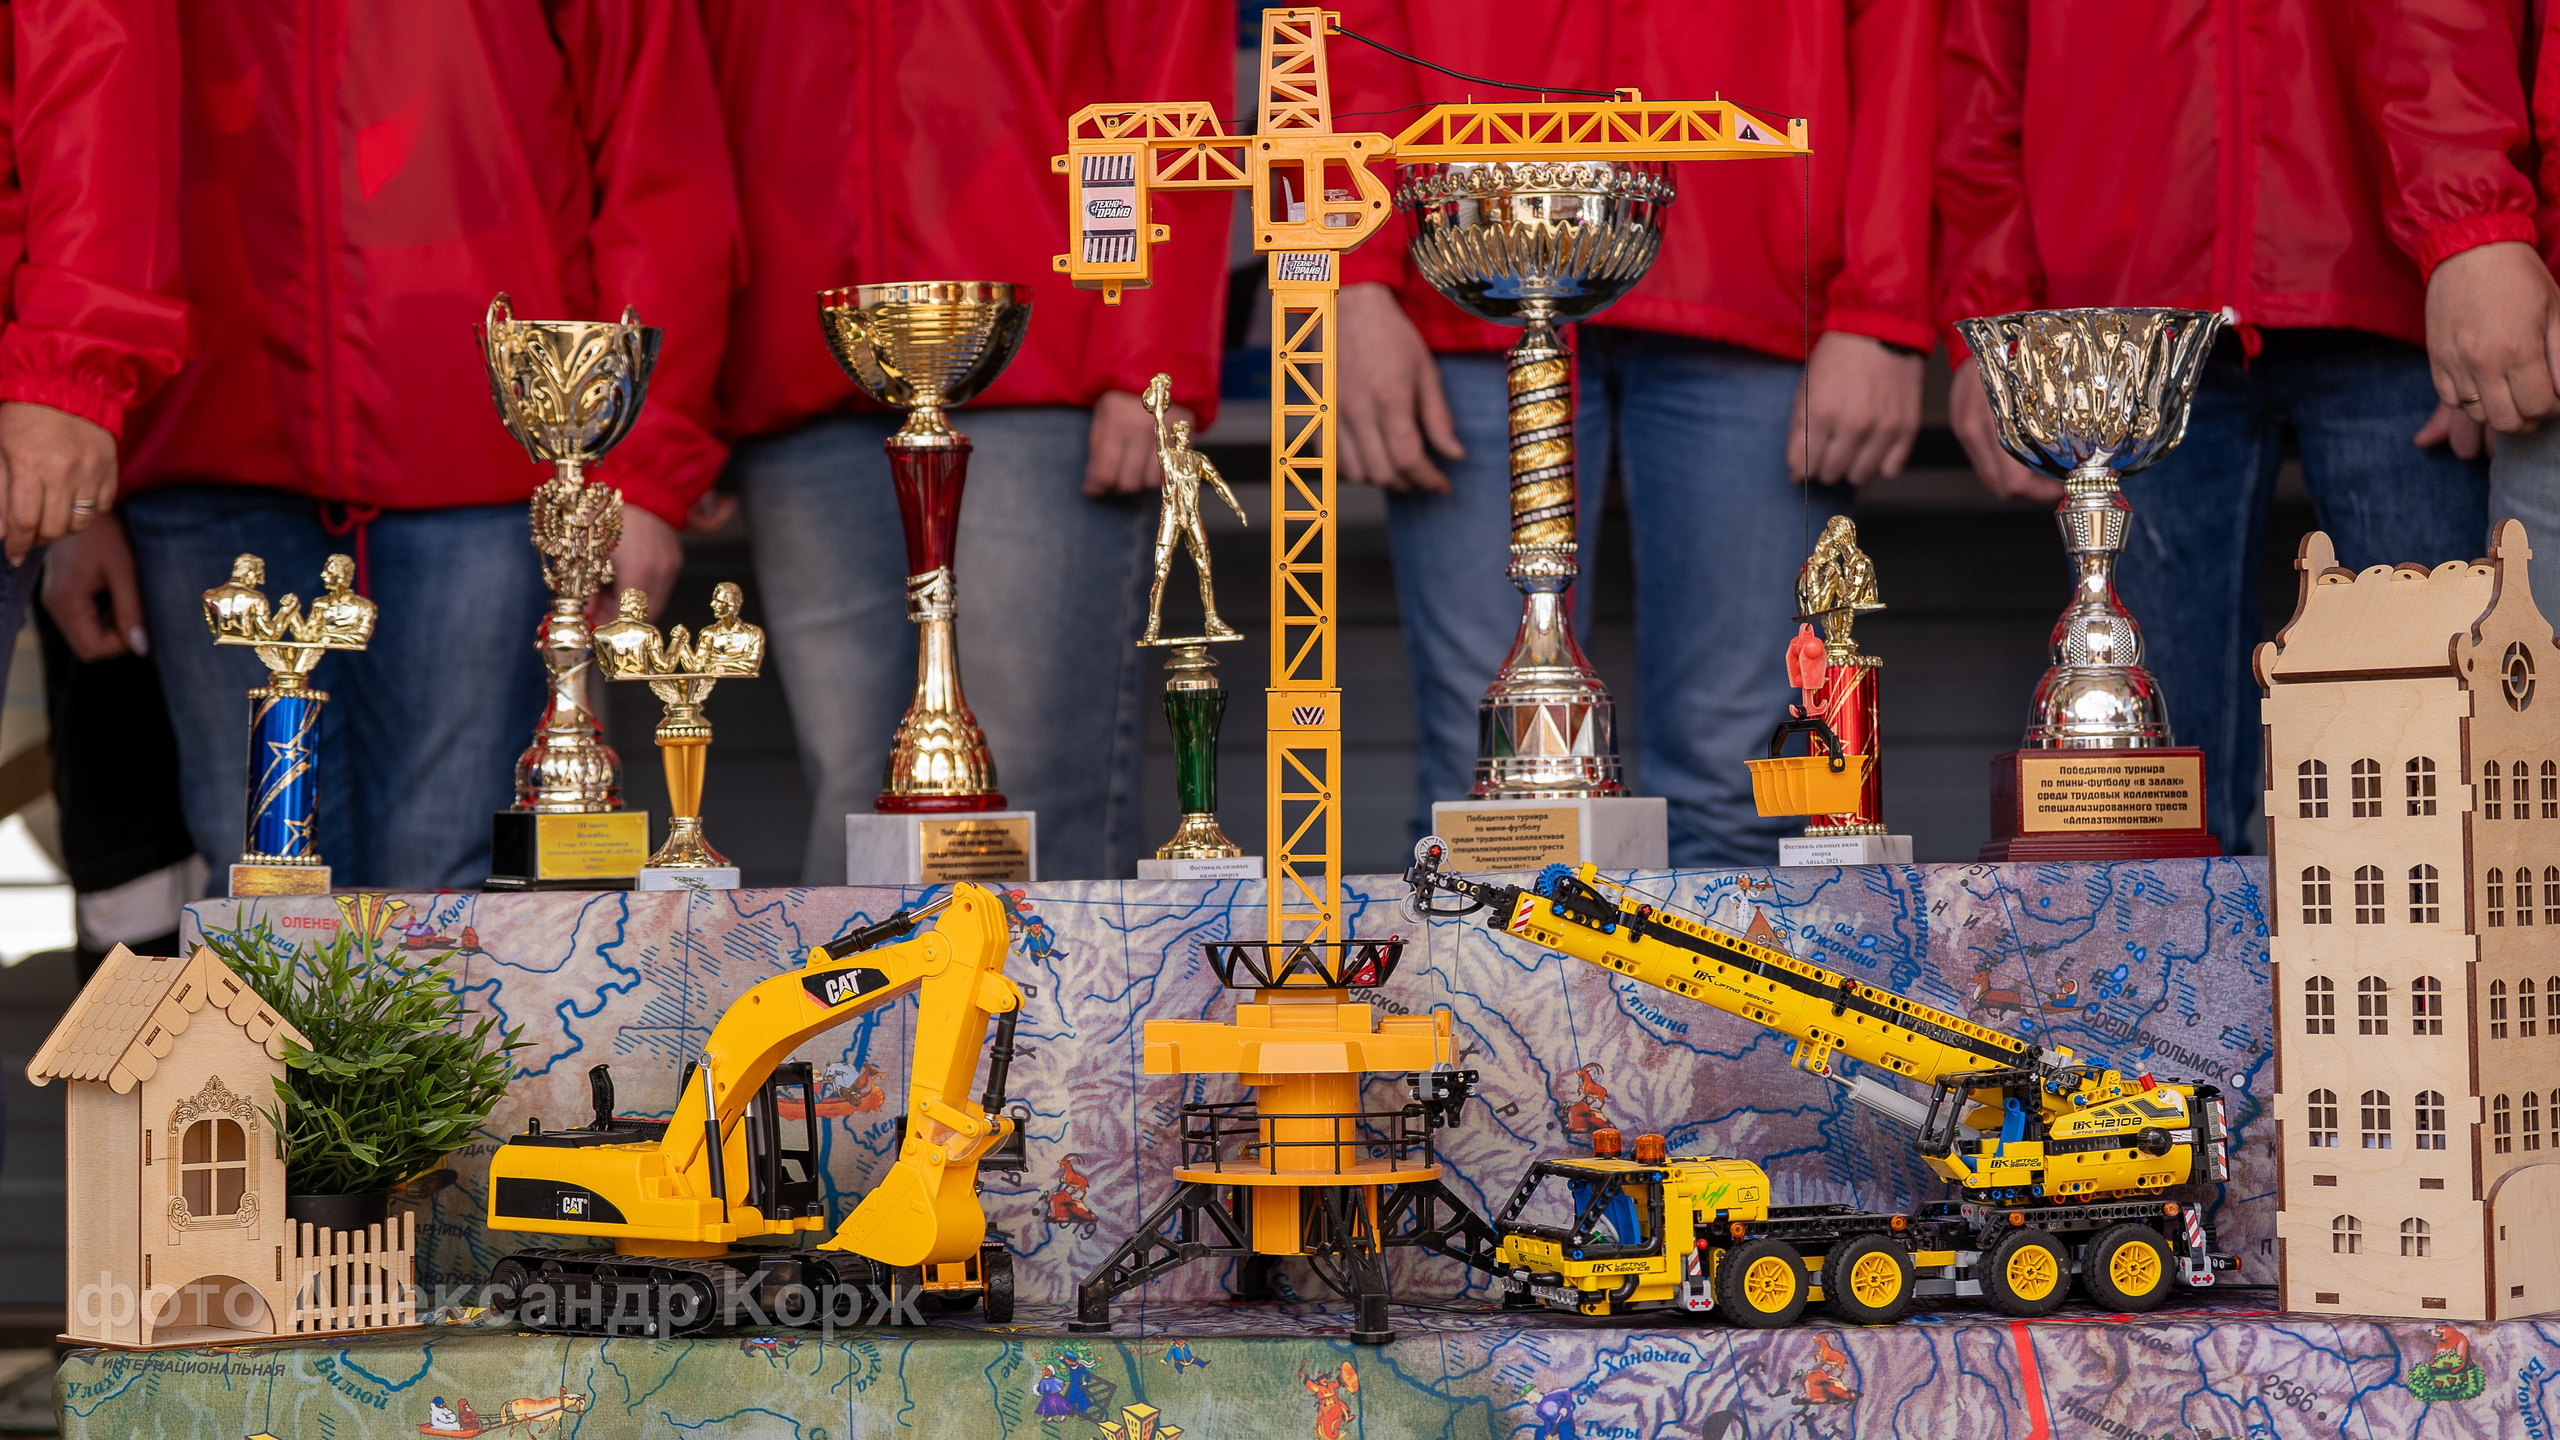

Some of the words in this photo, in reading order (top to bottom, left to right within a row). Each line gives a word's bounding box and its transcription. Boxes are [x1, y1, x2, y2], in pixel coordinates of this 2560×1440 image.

[2060, 766, 2121, 776] Победителю
[2124, 765, 2165, 775] турнира
[2041, 779, 2053, 787] по
[2056, 778, 2130, 788] мини-футболу
[2148, 778, 2184, 786] залах»
[2037, 791, 2068, 801] среди
[2070, 790, 2121, 800] трудовых
[2123, 789, 2189, 799] коллективов
[2038, 803, 2152, 813] специализированного
[2155, 802, 2188, 811] треста
[1466, 814, 1515, 823] Победителю
[1517, 813, 1549, 823] турнира
[2063, 815, 2164, 825] «Алмазтехмонтаж»
[982, 828, 1010, 837] турнира
[1485, 823, 1541, 833] мини-футболу
[1451, 837, 1474, 845] среди
[1476, 835, 1513, 844] трудовых
[1452, 845, 1538, 854] специализированного
[1539, 843, 1565, 852] треста
[281, 916, 340, 931] ОЛЕНЕК
[1835, 922, 1856, 938] оз.
[1800, 924, 1878, 969] Ожогино
[1713, 981, 1741, 994] LIFTING
[1743, 991, 1774, 1006] SERVICE
[1620, 981, 1689, 1034] Уяндина
[2081, 1002, 2228, 1081] Среднеколымск
[2093, 1117, 2142, 1128] 42108
[414, 1223, 473, 1237] АРНИЦА
[101, 1356, 286, 1378] ИНТЕРНАЦИОНАЛЬНАЯ
[1601, 1345, 1691, 1377] Хандыга
[313, 1355, 389, 1410] Вилюй
[2259, 1374, 2319, 1413] 2586
